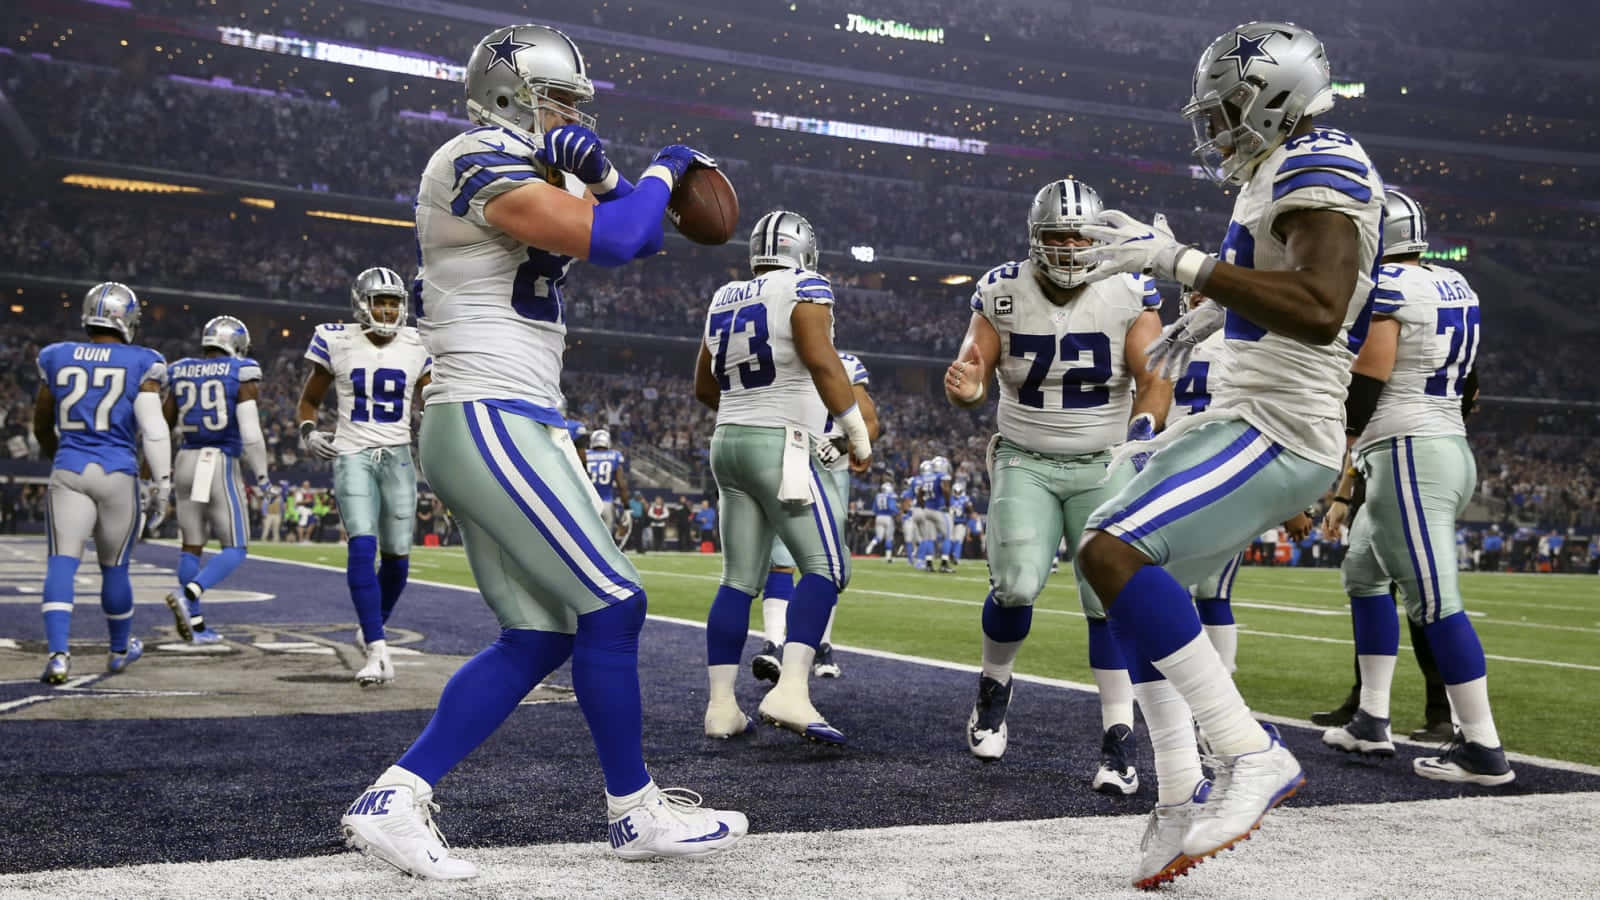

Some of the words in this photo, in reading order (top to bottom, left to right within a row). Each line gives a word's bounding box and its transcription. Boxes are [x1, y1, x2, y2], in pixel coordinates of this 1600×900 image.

[996, 296, 1011, 310] C
[73, 346, 111, 362] QUIN
[709, 302, 776, 391] 73
[1009, 332, 1112, 409] 72
[56, 366, 125, 431] 27
[176, 379, 228, 431] 29
[350, 368, 407, 423] 19
[1174, 361, 1212, 415] 4
[586, 461, 612, 485] 59
